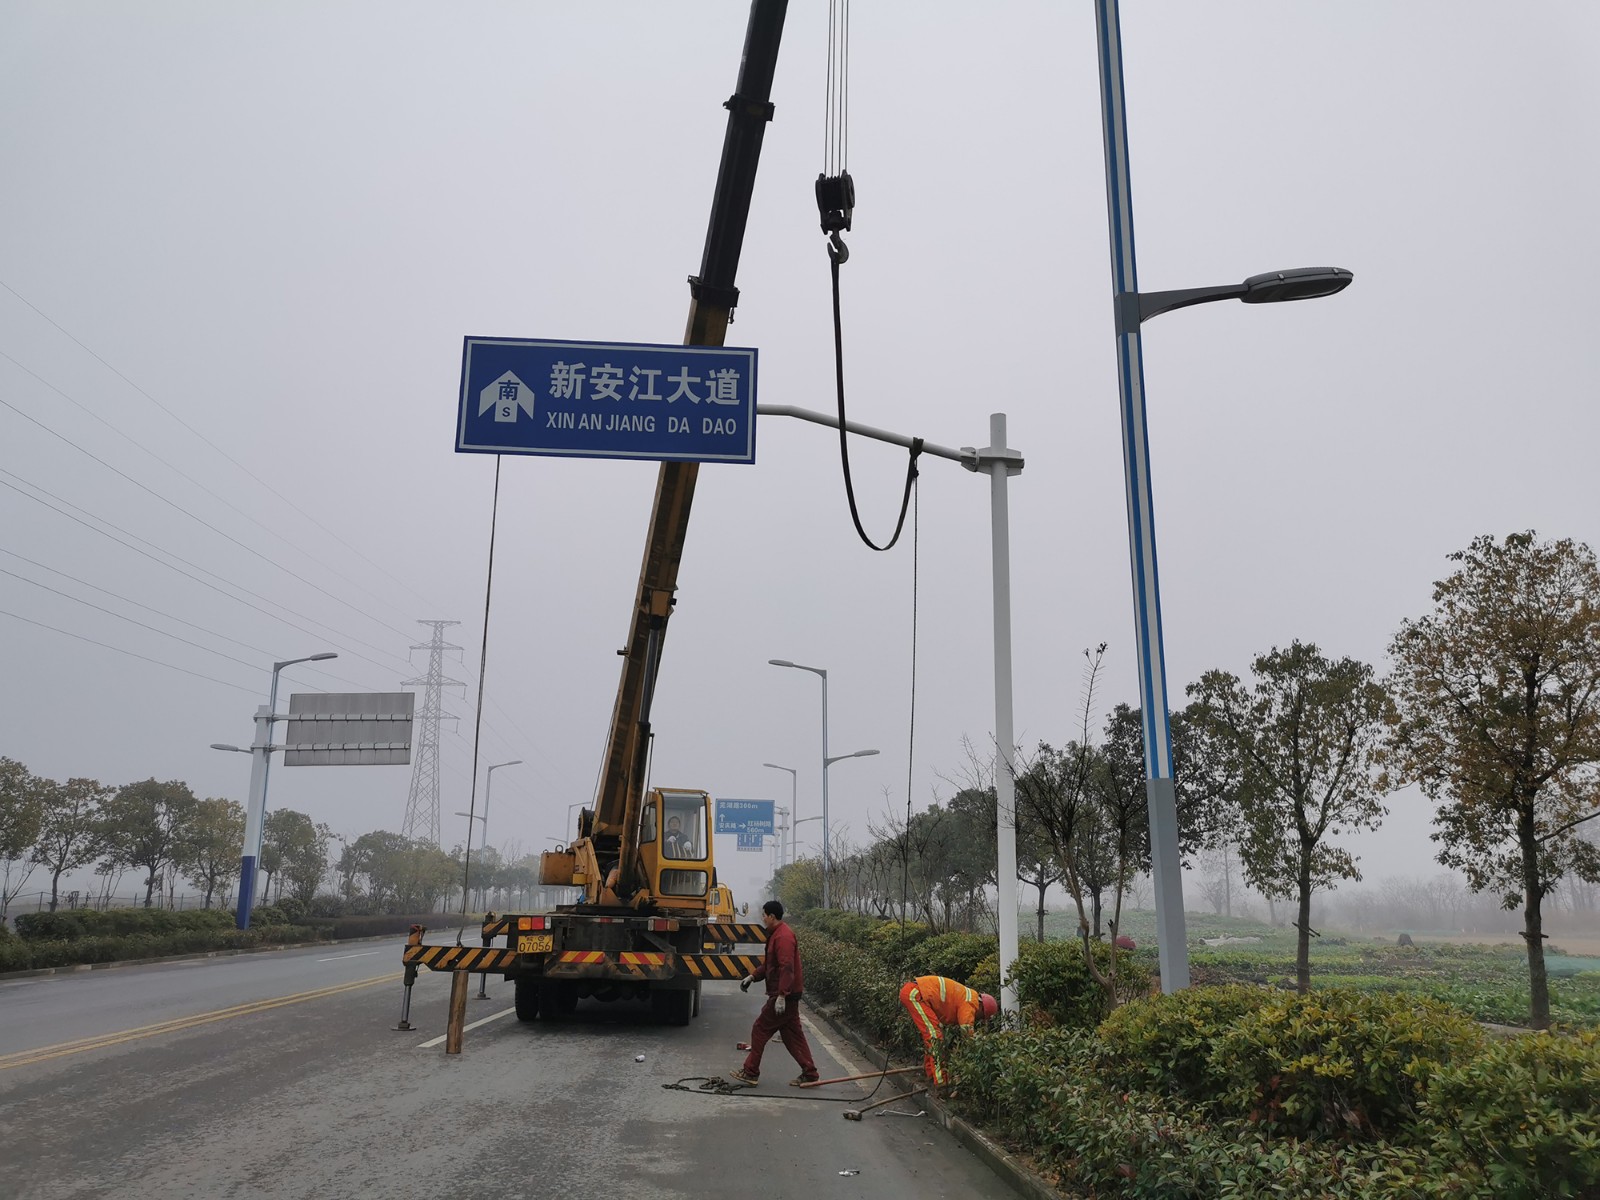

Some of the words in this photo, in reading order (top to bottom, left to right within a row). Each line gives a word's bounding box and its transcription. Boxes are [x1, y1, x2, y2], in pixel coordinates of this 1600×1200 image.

[498, 379, 520, 401] 南
[549, 361, 741, 405] 新安江大道
[502, 406, 511, 418] S
[668, 416, 690, 433] DA
[702, 418, 737, 435] DAO
[519, 942, 551, 952] 07056
